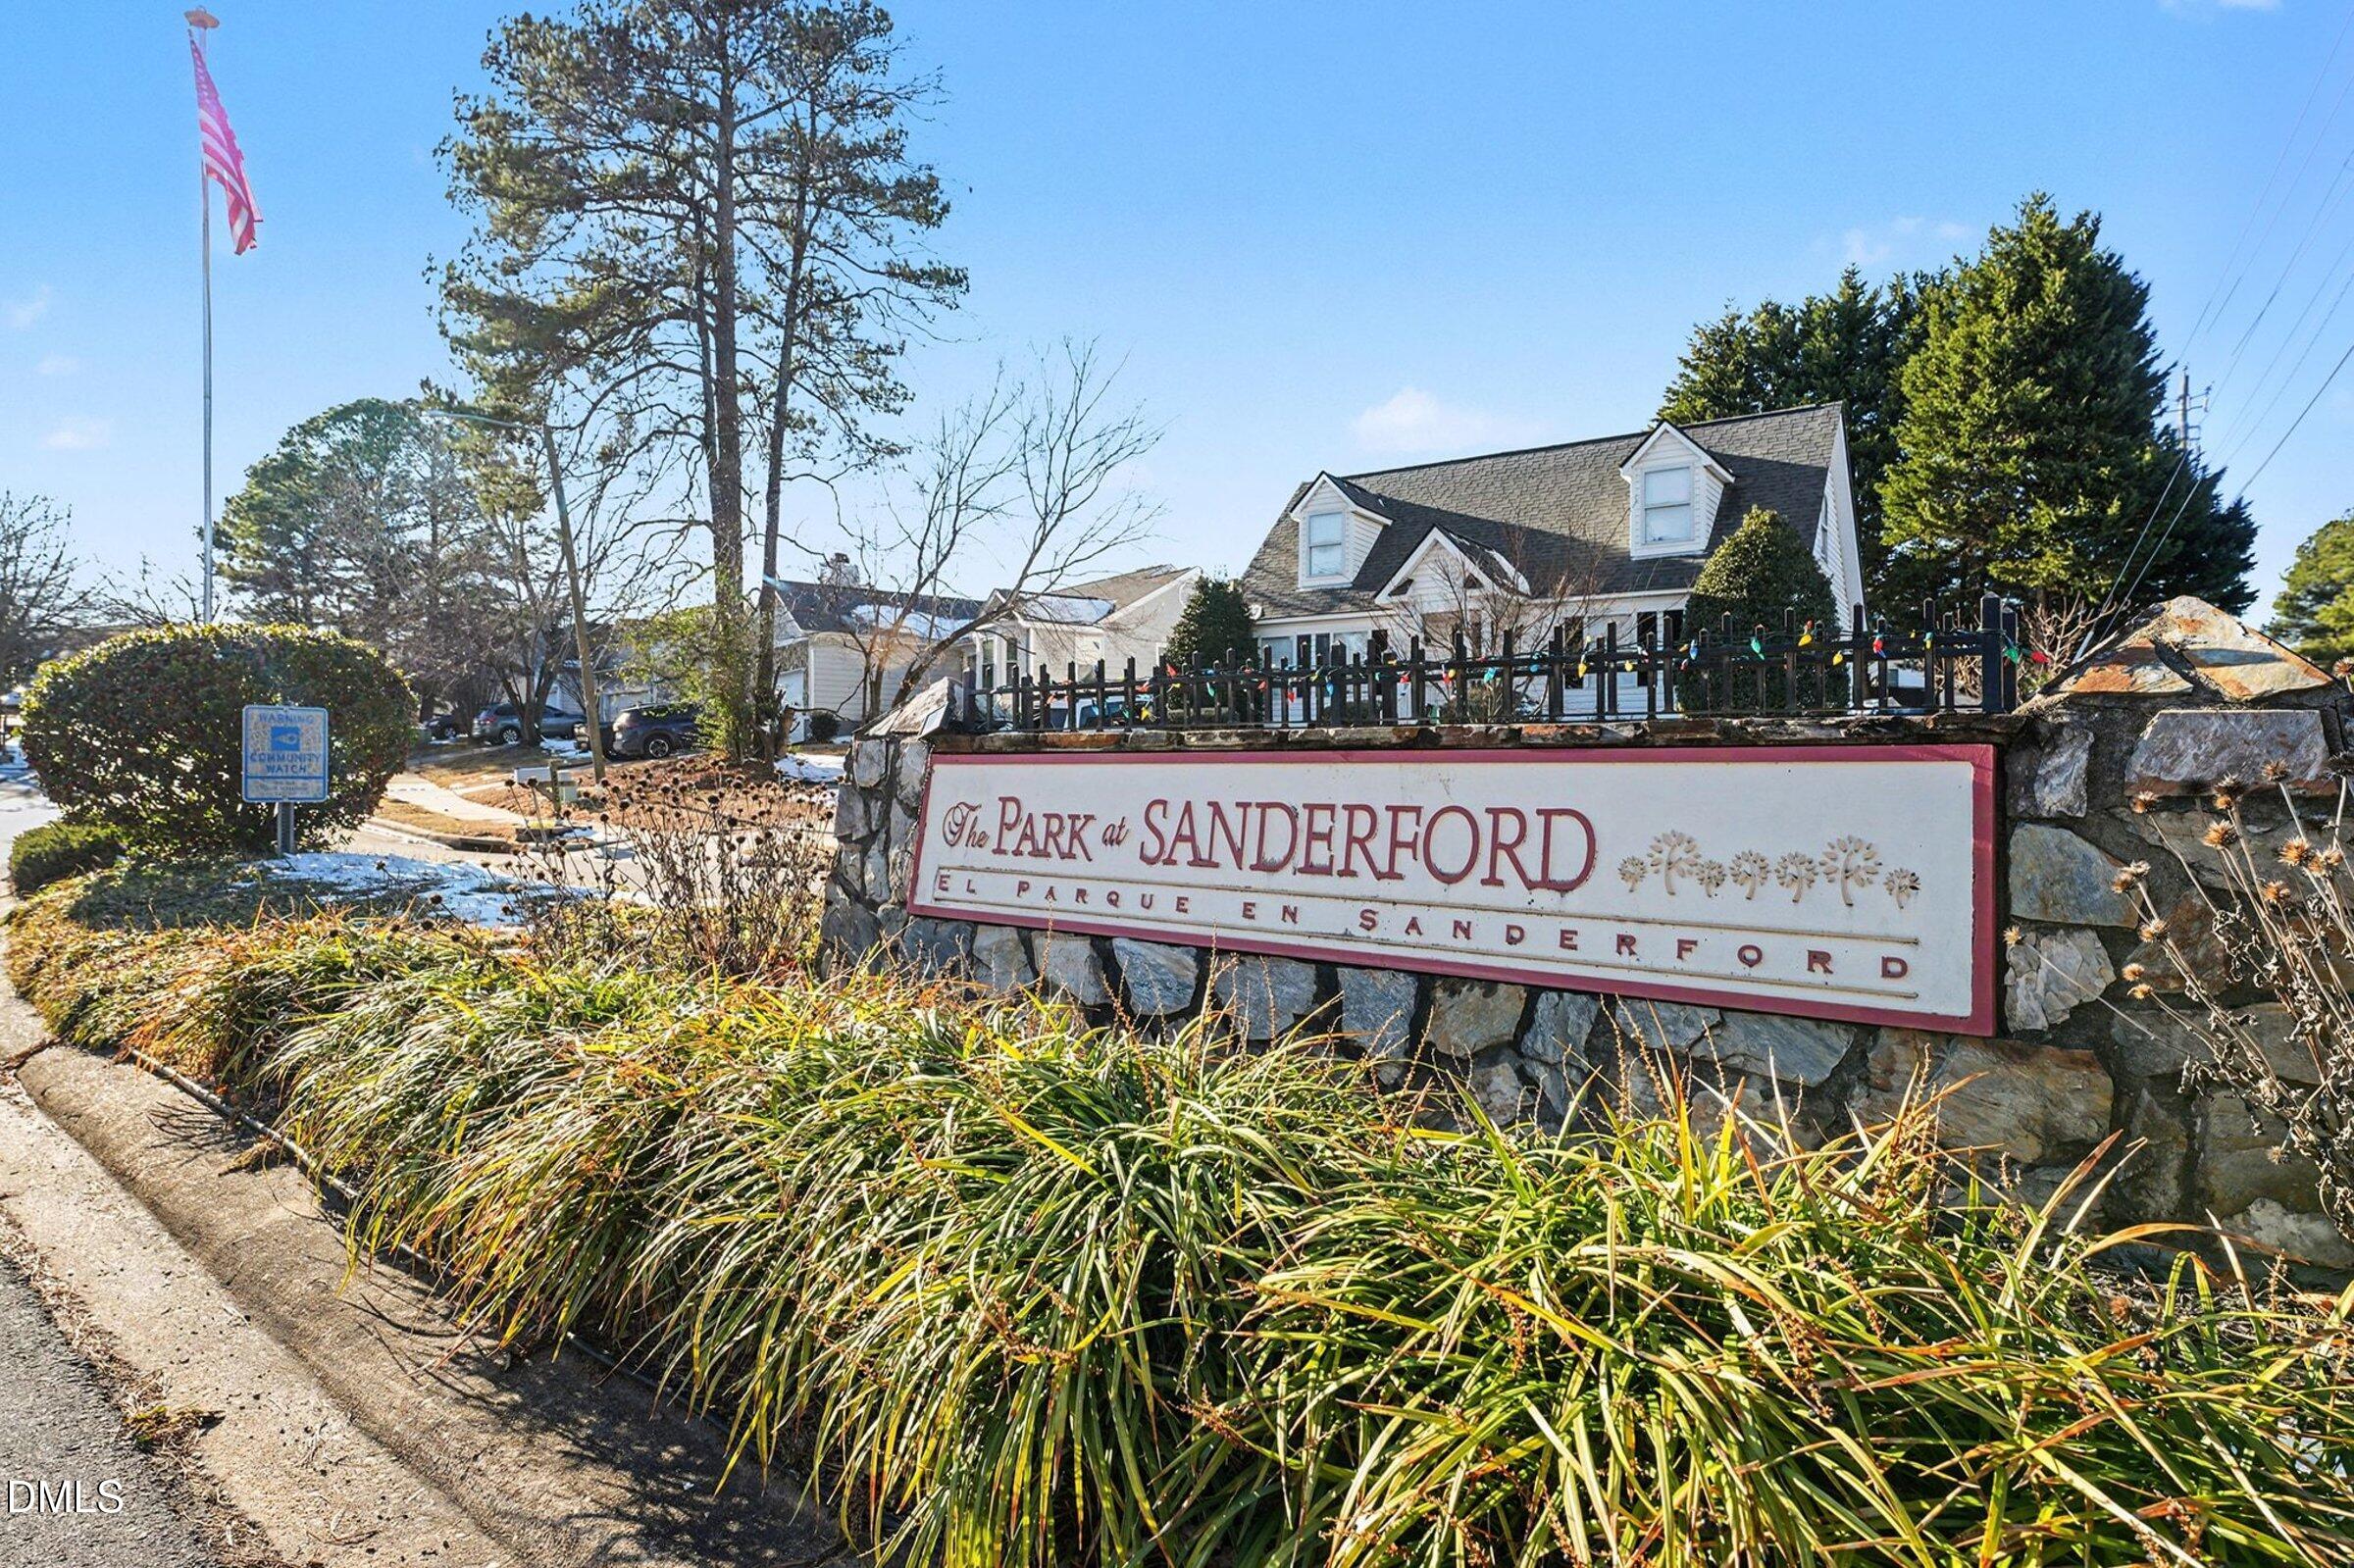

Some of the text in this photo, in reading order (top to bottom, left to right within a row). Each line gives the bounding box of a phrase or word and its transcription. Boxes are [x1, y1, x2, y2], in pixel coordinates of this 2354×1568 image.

[259, 713, 315, 724] WARNING
[249, 752, 322, 763] COMMUNITY
[266, 764, 307, 774] WATCH
[942, 795, 1597, 892] The PARK at SANDERFORD
[937, 873, 1909, 980] EL PARQUE EN SANDERFORD
